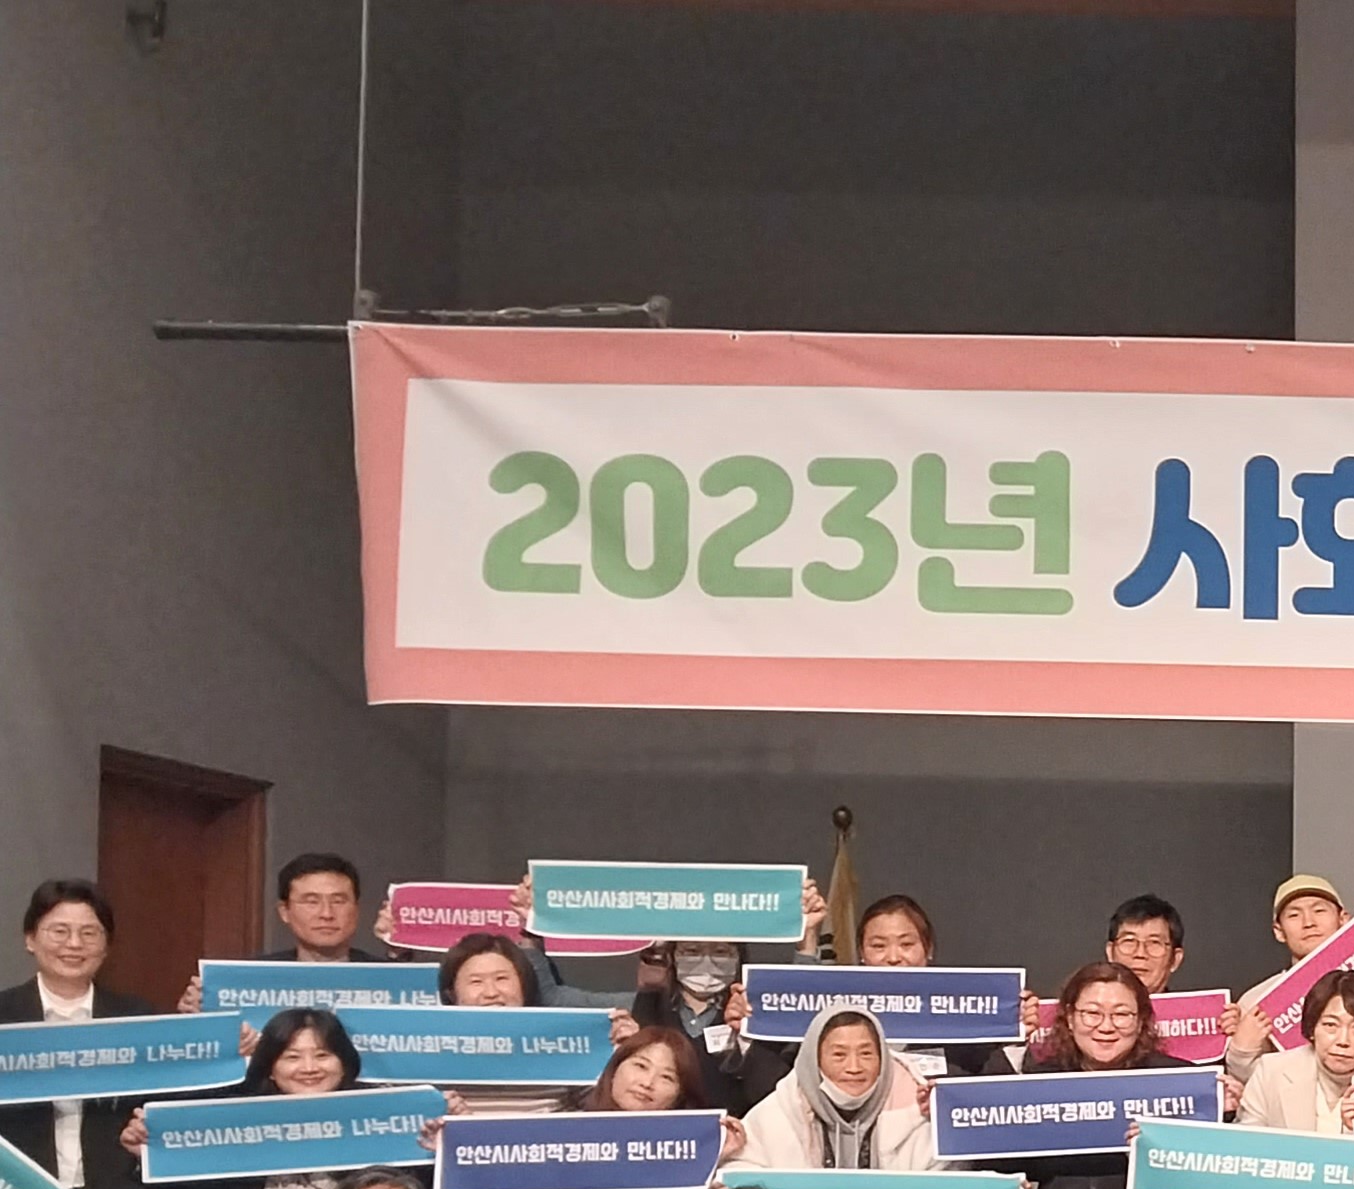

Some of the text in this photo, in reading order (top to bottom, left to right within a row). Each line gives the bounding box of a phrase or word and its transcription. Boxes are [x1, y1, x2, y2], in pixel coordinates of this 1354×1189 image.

[478, 449, 1076, 617] 2023년
[547, 890, 781, 913] 안산시사회적경제와 만나다!!
[931, 996, 999, 1016] 만나다!!
[147, 1041, 221, 1063] 나누다!!
[352, 1035, 592, 1056] 안산시사회적경제와 나누다!!
[952, 1097, 1196, 1129] 안산시사회적경제와 만나다!!
[163, 1113, 425, 1150] 안산시사회적경제와 나누다!!
[456, 1140, 697, 1166] 안산시사회적경제와 만나다!!
[1149, 1149, 1317, 1182] 안산시사회적경제와
